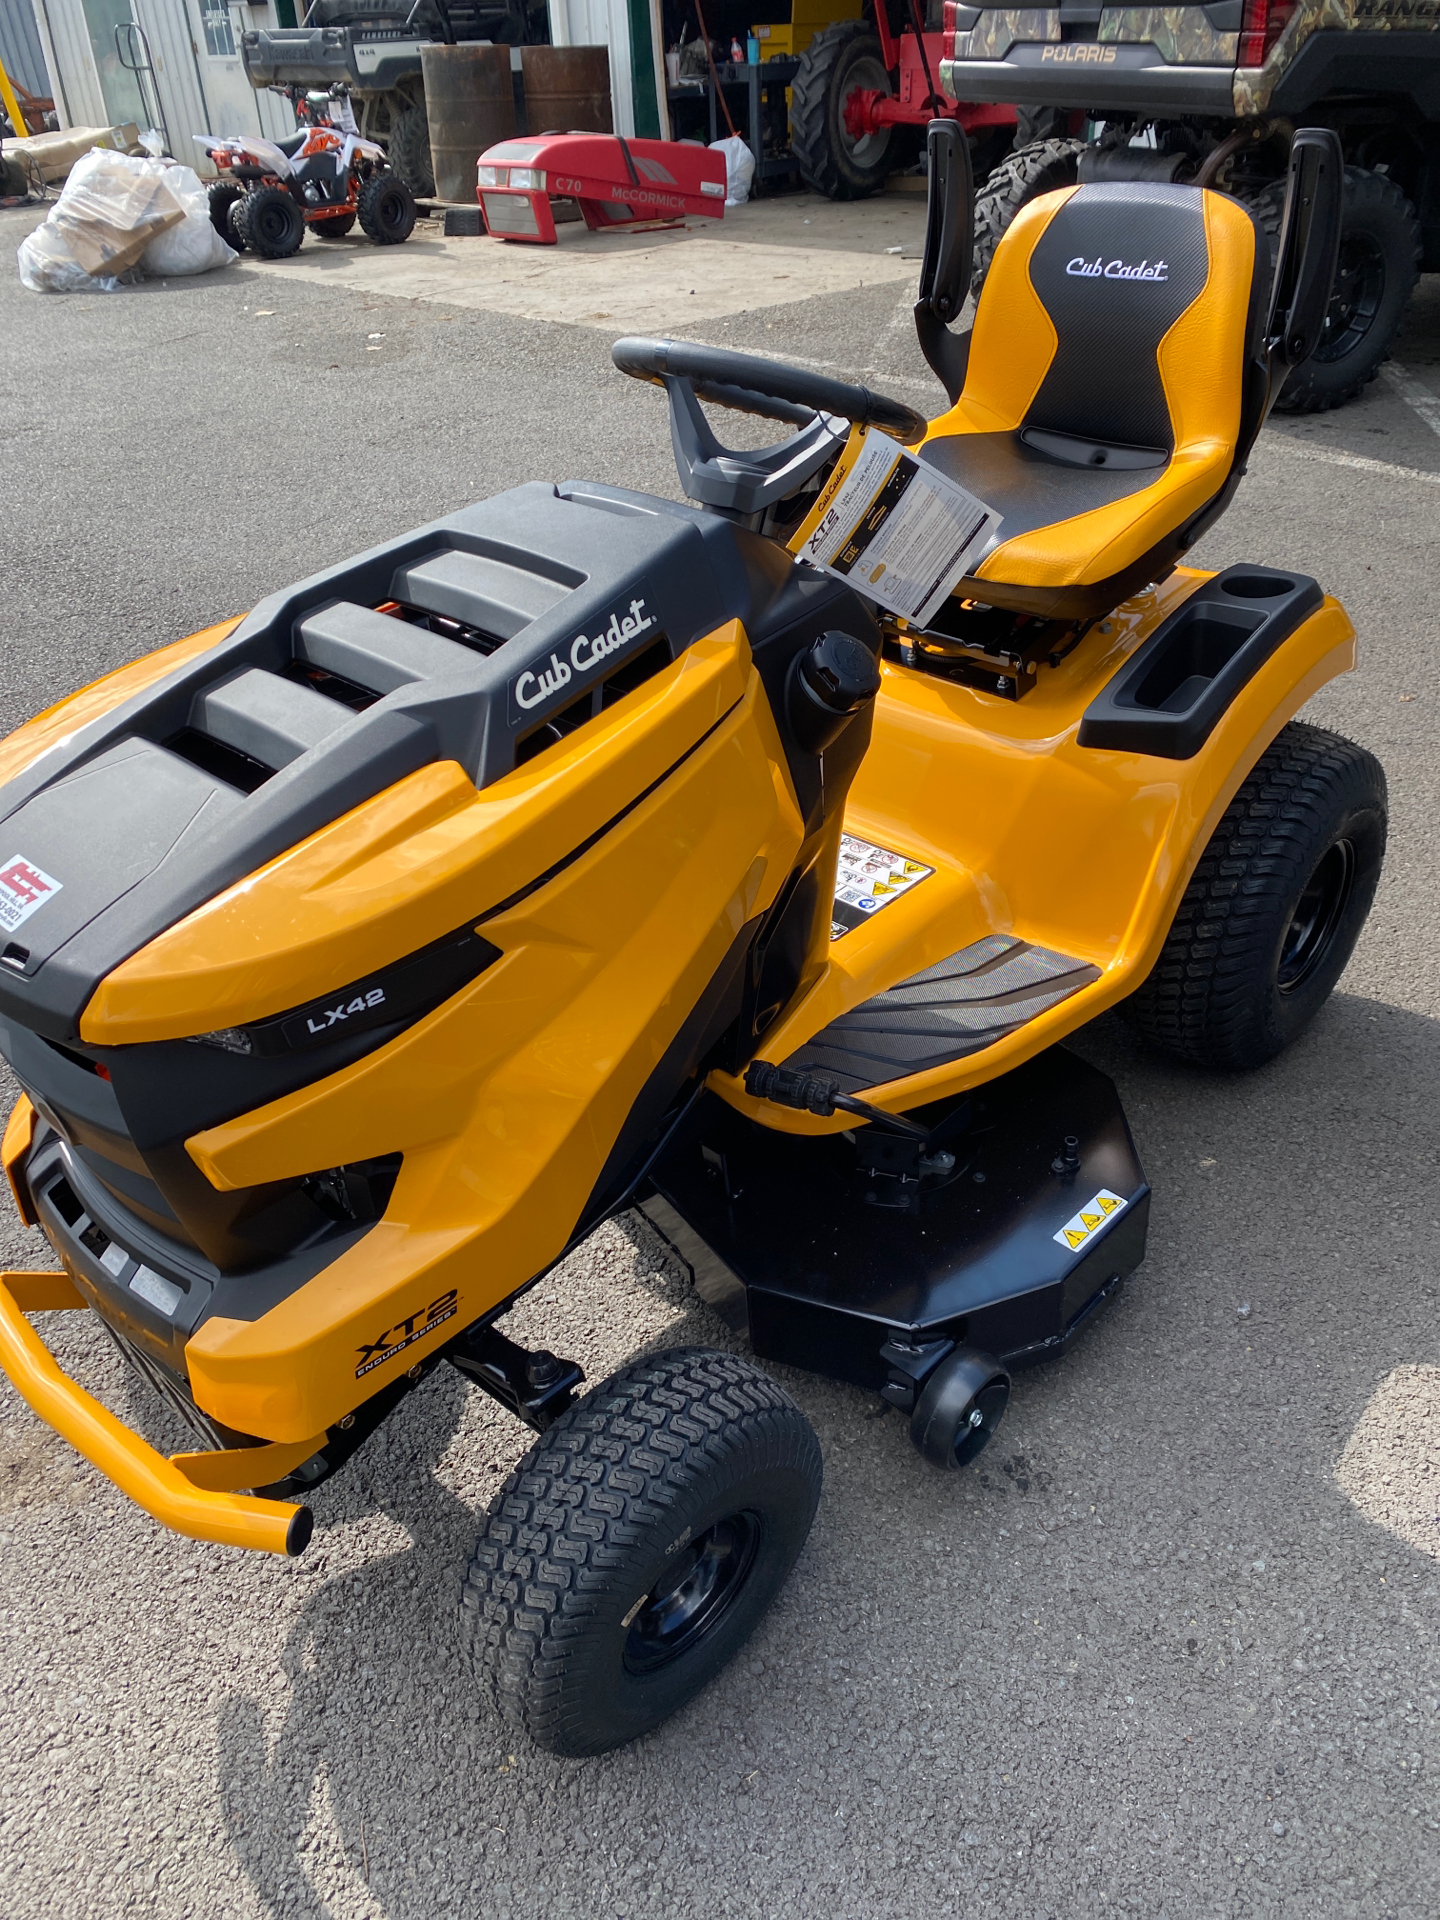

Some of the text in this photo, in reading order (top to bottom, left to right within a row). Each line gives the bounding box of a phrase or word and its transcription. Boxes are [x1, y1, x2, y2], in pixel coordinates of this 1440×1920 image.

[1353, 0, 1440, 17] RANG
[1041, 45, 1117, 62] POLARIS
[555, 177, 581, 193] C70
[1066, 257, 1168, 281] Cub Cadet
[818, 494, 831, 512] Cub
[828, 465, 847, 495] Cadet
[844, 482, 861, 507] TRACTEUR
[808, 508, 837, 550] XT2
[515, 599, 652, 709] Cub Cadet
[306, 988, 386, 1034] LX42
[355, 1288, 458, 1369] XT2
[357, 1311, 451, 1376] ENDURO SERIES
